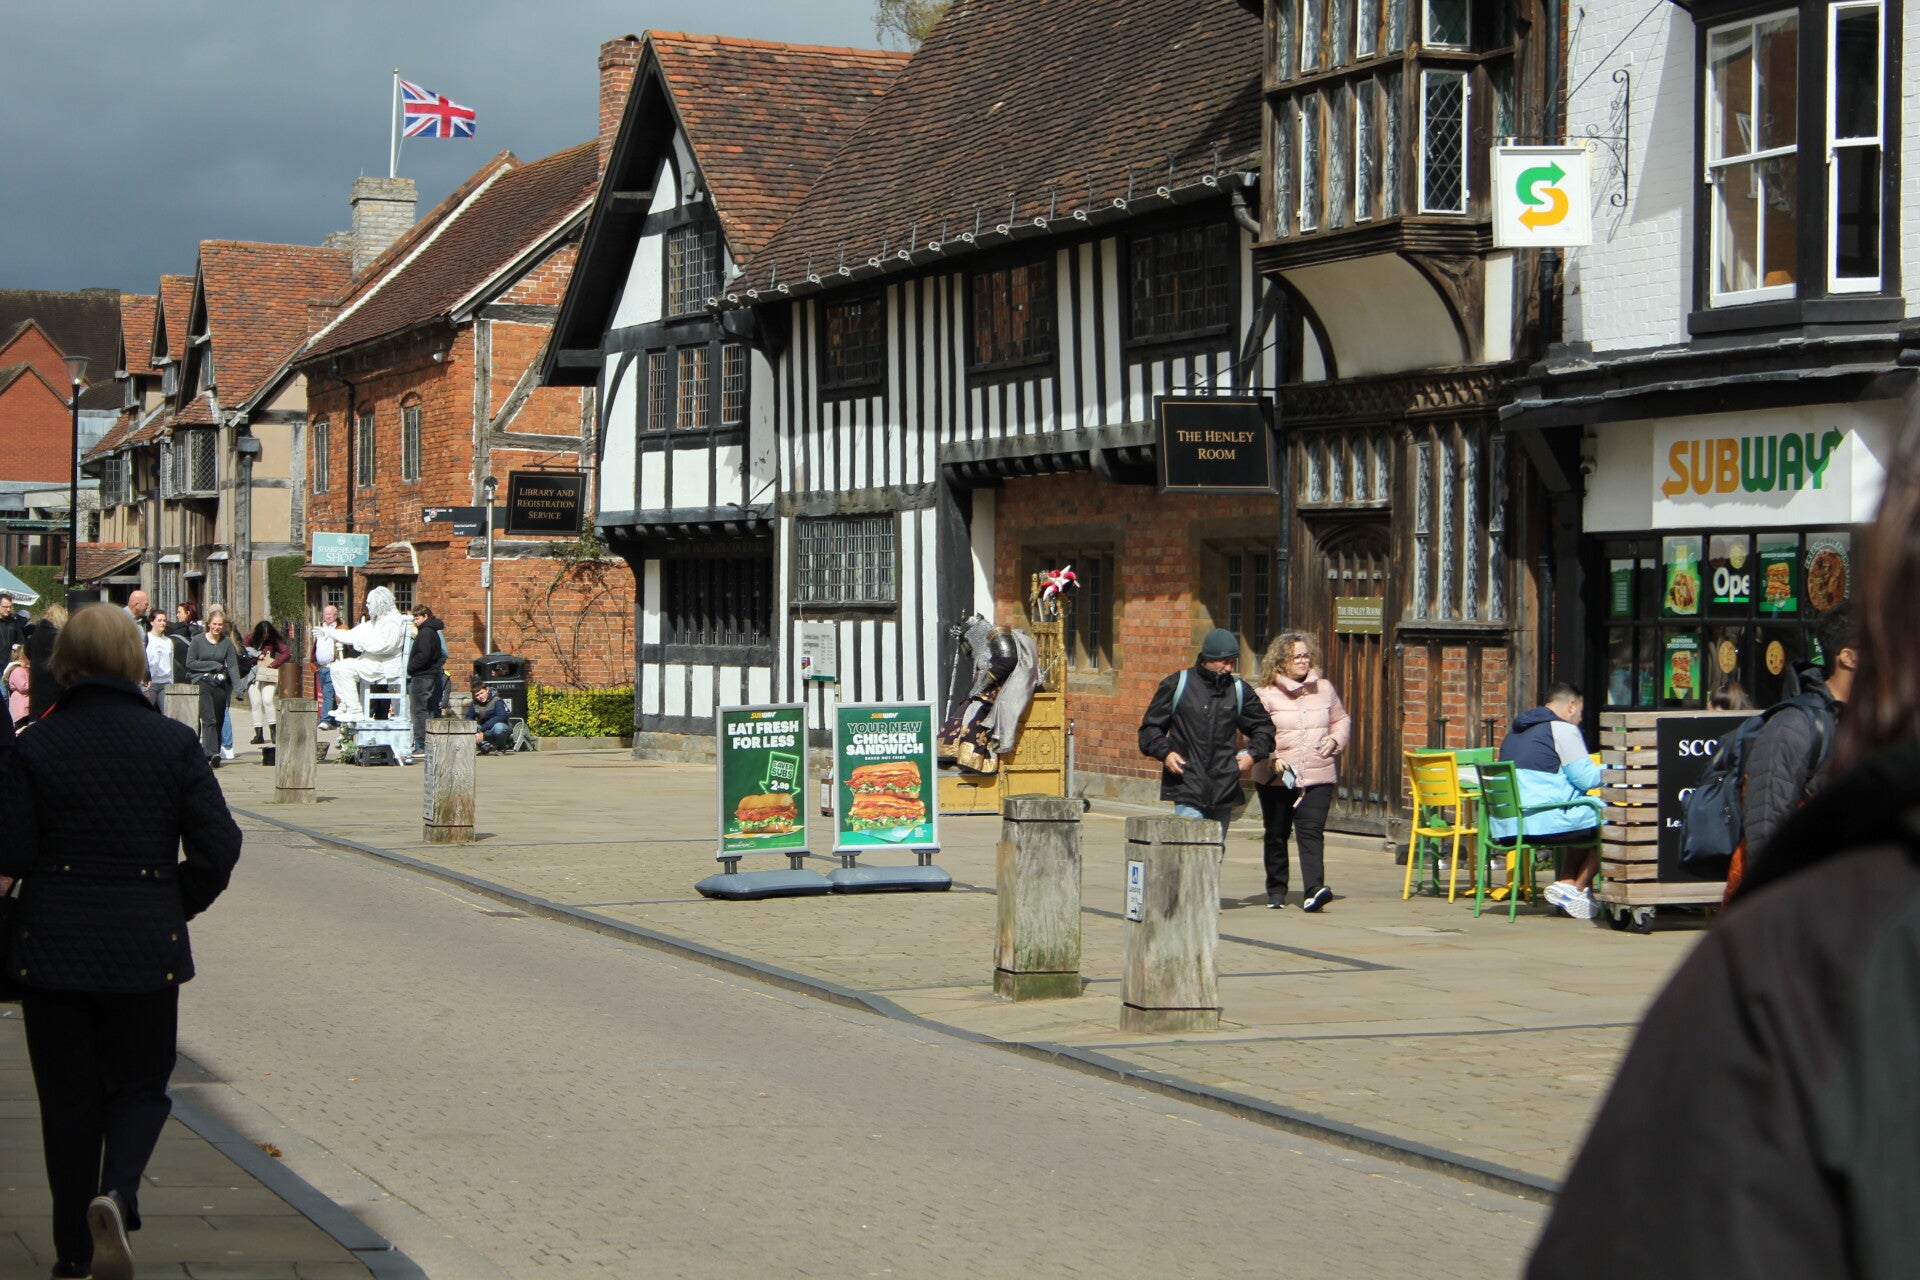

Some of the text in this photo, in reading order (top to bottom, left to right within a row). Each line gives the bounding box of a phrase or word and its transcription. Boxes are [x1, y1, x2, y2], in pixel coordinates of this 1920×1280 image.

[1176, 430, 1254, 443] THE HENLEY
[1197, 448, 1236, 460] ROOM
[1660, 425, 1844, 500] SUBWAY
[519, 487, 575, 498] LIBRARY AND
[517, 499, 575, 509] REGISTRATION
[528, 511, 561, 520] SERVICE
[326, 552, 356, 563] SHOP
[751, 711, 777, 719] SUBWAY
[727, 720, 799, 735] EAT FRESH
[847, 721, 922, 734] YOUR NEW
[732, 734, 795, 750] FOR LESS
[852, 732, 917, 745] CHICKEN
[846, 743, 923, 756] SANDWICH
[772, 760, 794, 771] SAVER
[770, 767, 793, 779] SUBS
